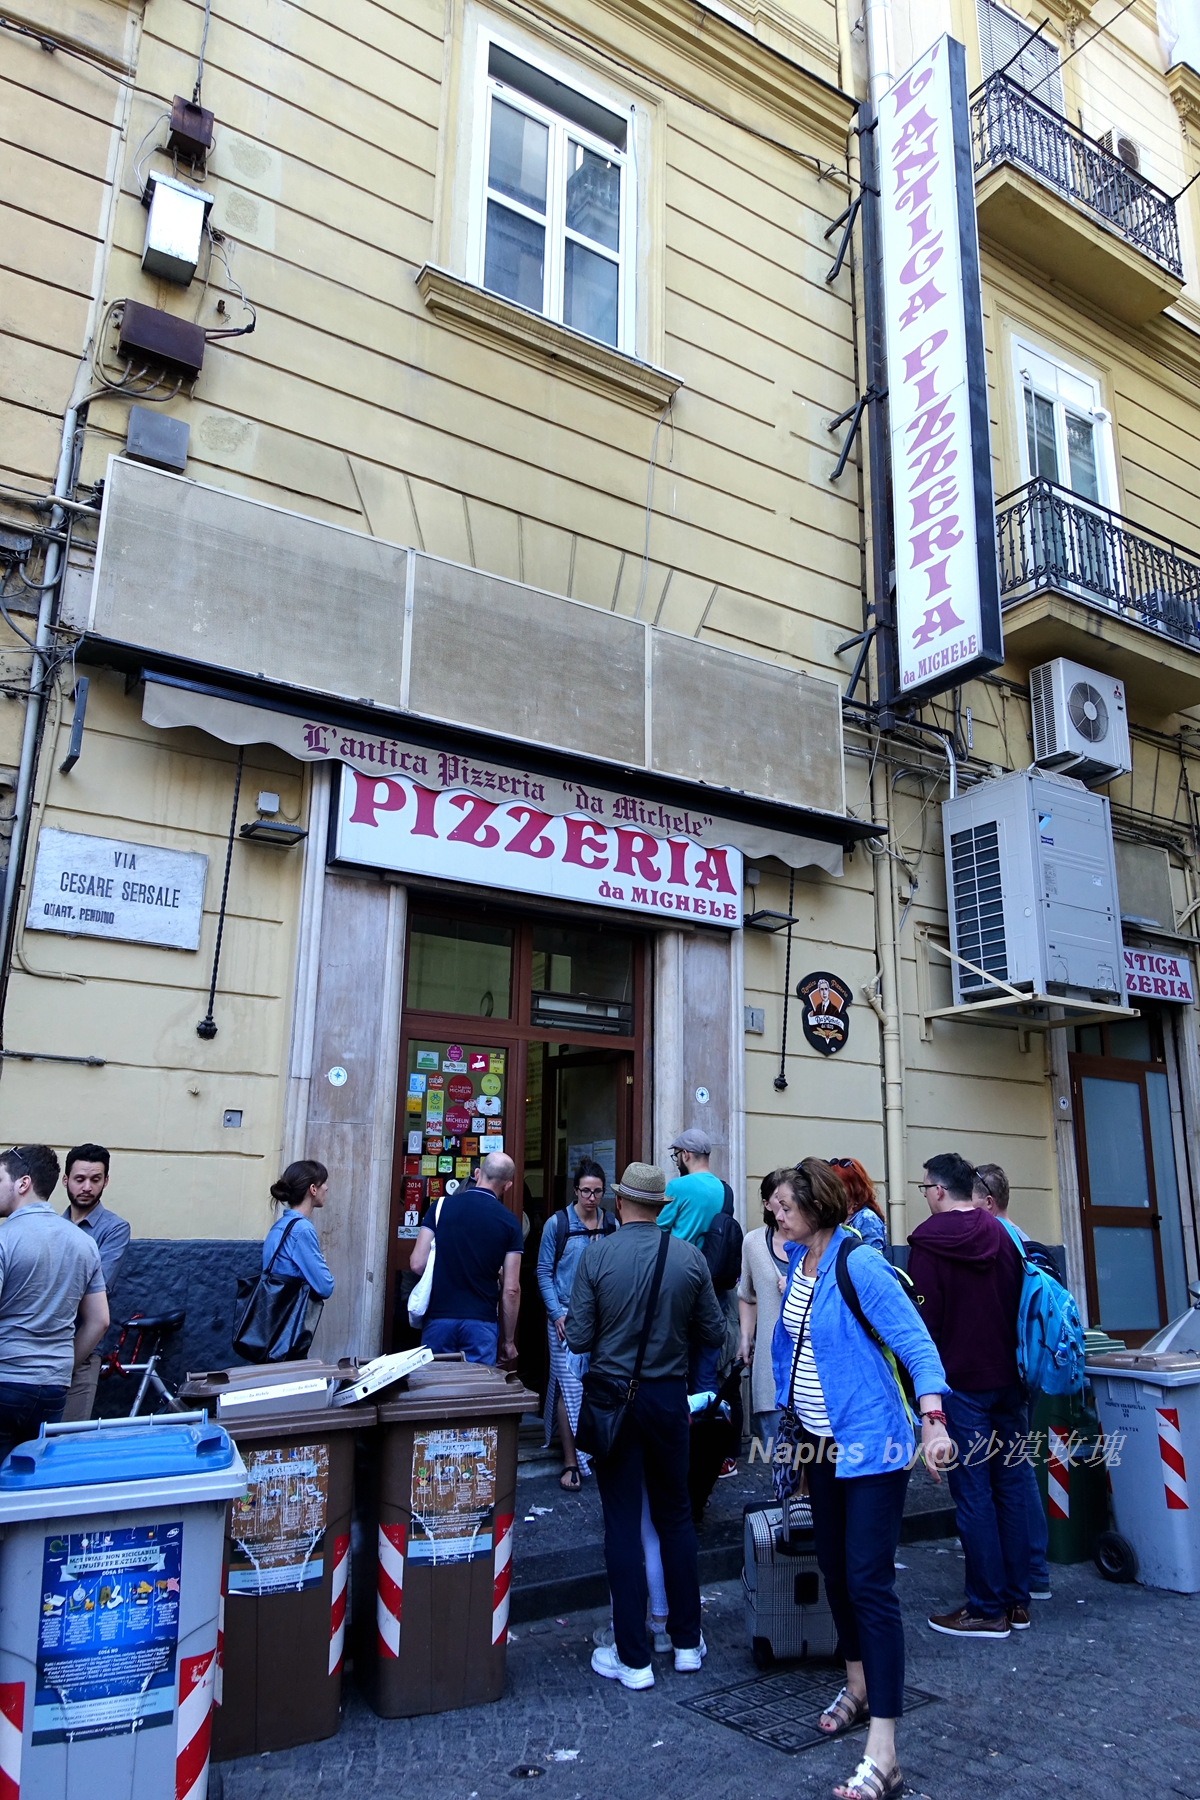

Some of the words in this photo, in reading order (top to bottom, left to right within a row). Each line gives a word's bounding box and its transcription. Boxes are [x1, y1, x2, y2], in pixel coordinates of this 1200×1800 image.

[901, 329, 964, 650] PIZZERIA
[903, 669, 916, 686] da
[917, 634, 978, 679] MICHELE
[302, 723, 429, 776] L'antica
[437, 752, 546, 802] Pizzeria
[349, 771, 738, 896] PIZZERIA
[114, 851, 137, 871] VIA
[60, 871, 114, 898] CESARE
[121, 880, 181, 909] SERSALE
[598, 880, 625, 901] da
[630, 886, 738, 921] MICHELE
[43, 902, 76, 920] QUART.
[79, 907, 115, 925] PENDINO
[1123, 951, 1182, 978] NTICA
[1125, 972, 1193, 1000] ZERIA
